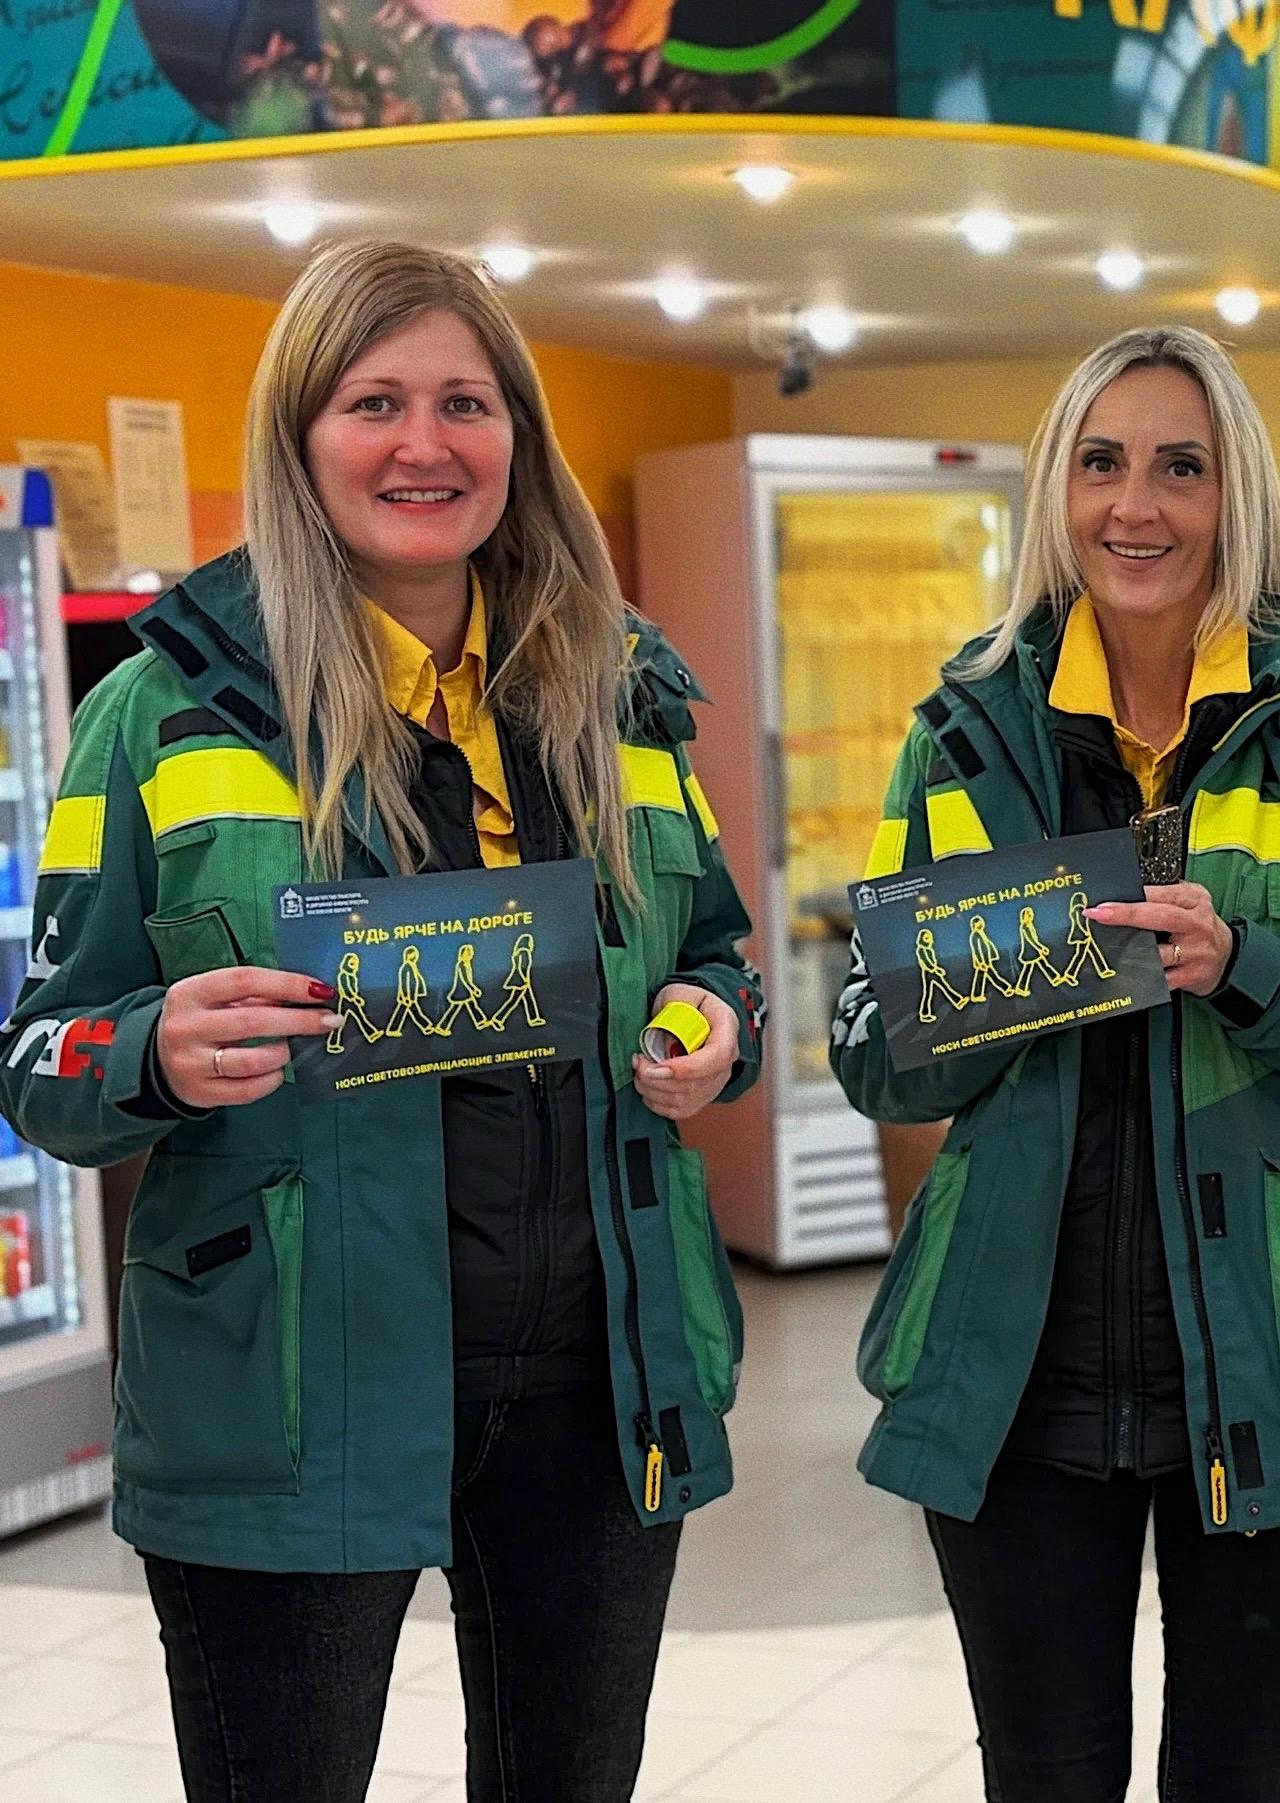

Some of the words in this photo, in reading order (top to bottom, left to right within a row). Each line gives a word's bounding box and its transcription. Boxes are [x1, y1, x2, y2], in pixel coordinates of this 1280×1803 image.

[915, 904, 956, 924] БУДЬ
[958, 892, 998, 912] ЯРЧЕ
[999, 887, 1021, 902] НА
[1023, 873, 1083, 898] ДОРОГЕ
[343, 928, 390, 945] БУДЬ
[393, 922, 437, 940] ЯРЧЕ
[440, 920, 464, 934] НА
[467, 912, 533, 934] ДОРОГЕ
[931, 1040, 961, 1055] НОСИ
[961, 1012, 1075, 1047] СВЕТОВОЗВРАЩАЮЩИЕ
[1076, 996, 1133, 1018] ЭЛЕМЕНТЫ!
[335, 1074, 366, 1091] НОСИ
[367, 1055, 493, 1083] СВЕТОВОЗВРАЩАЮЩИЕ
